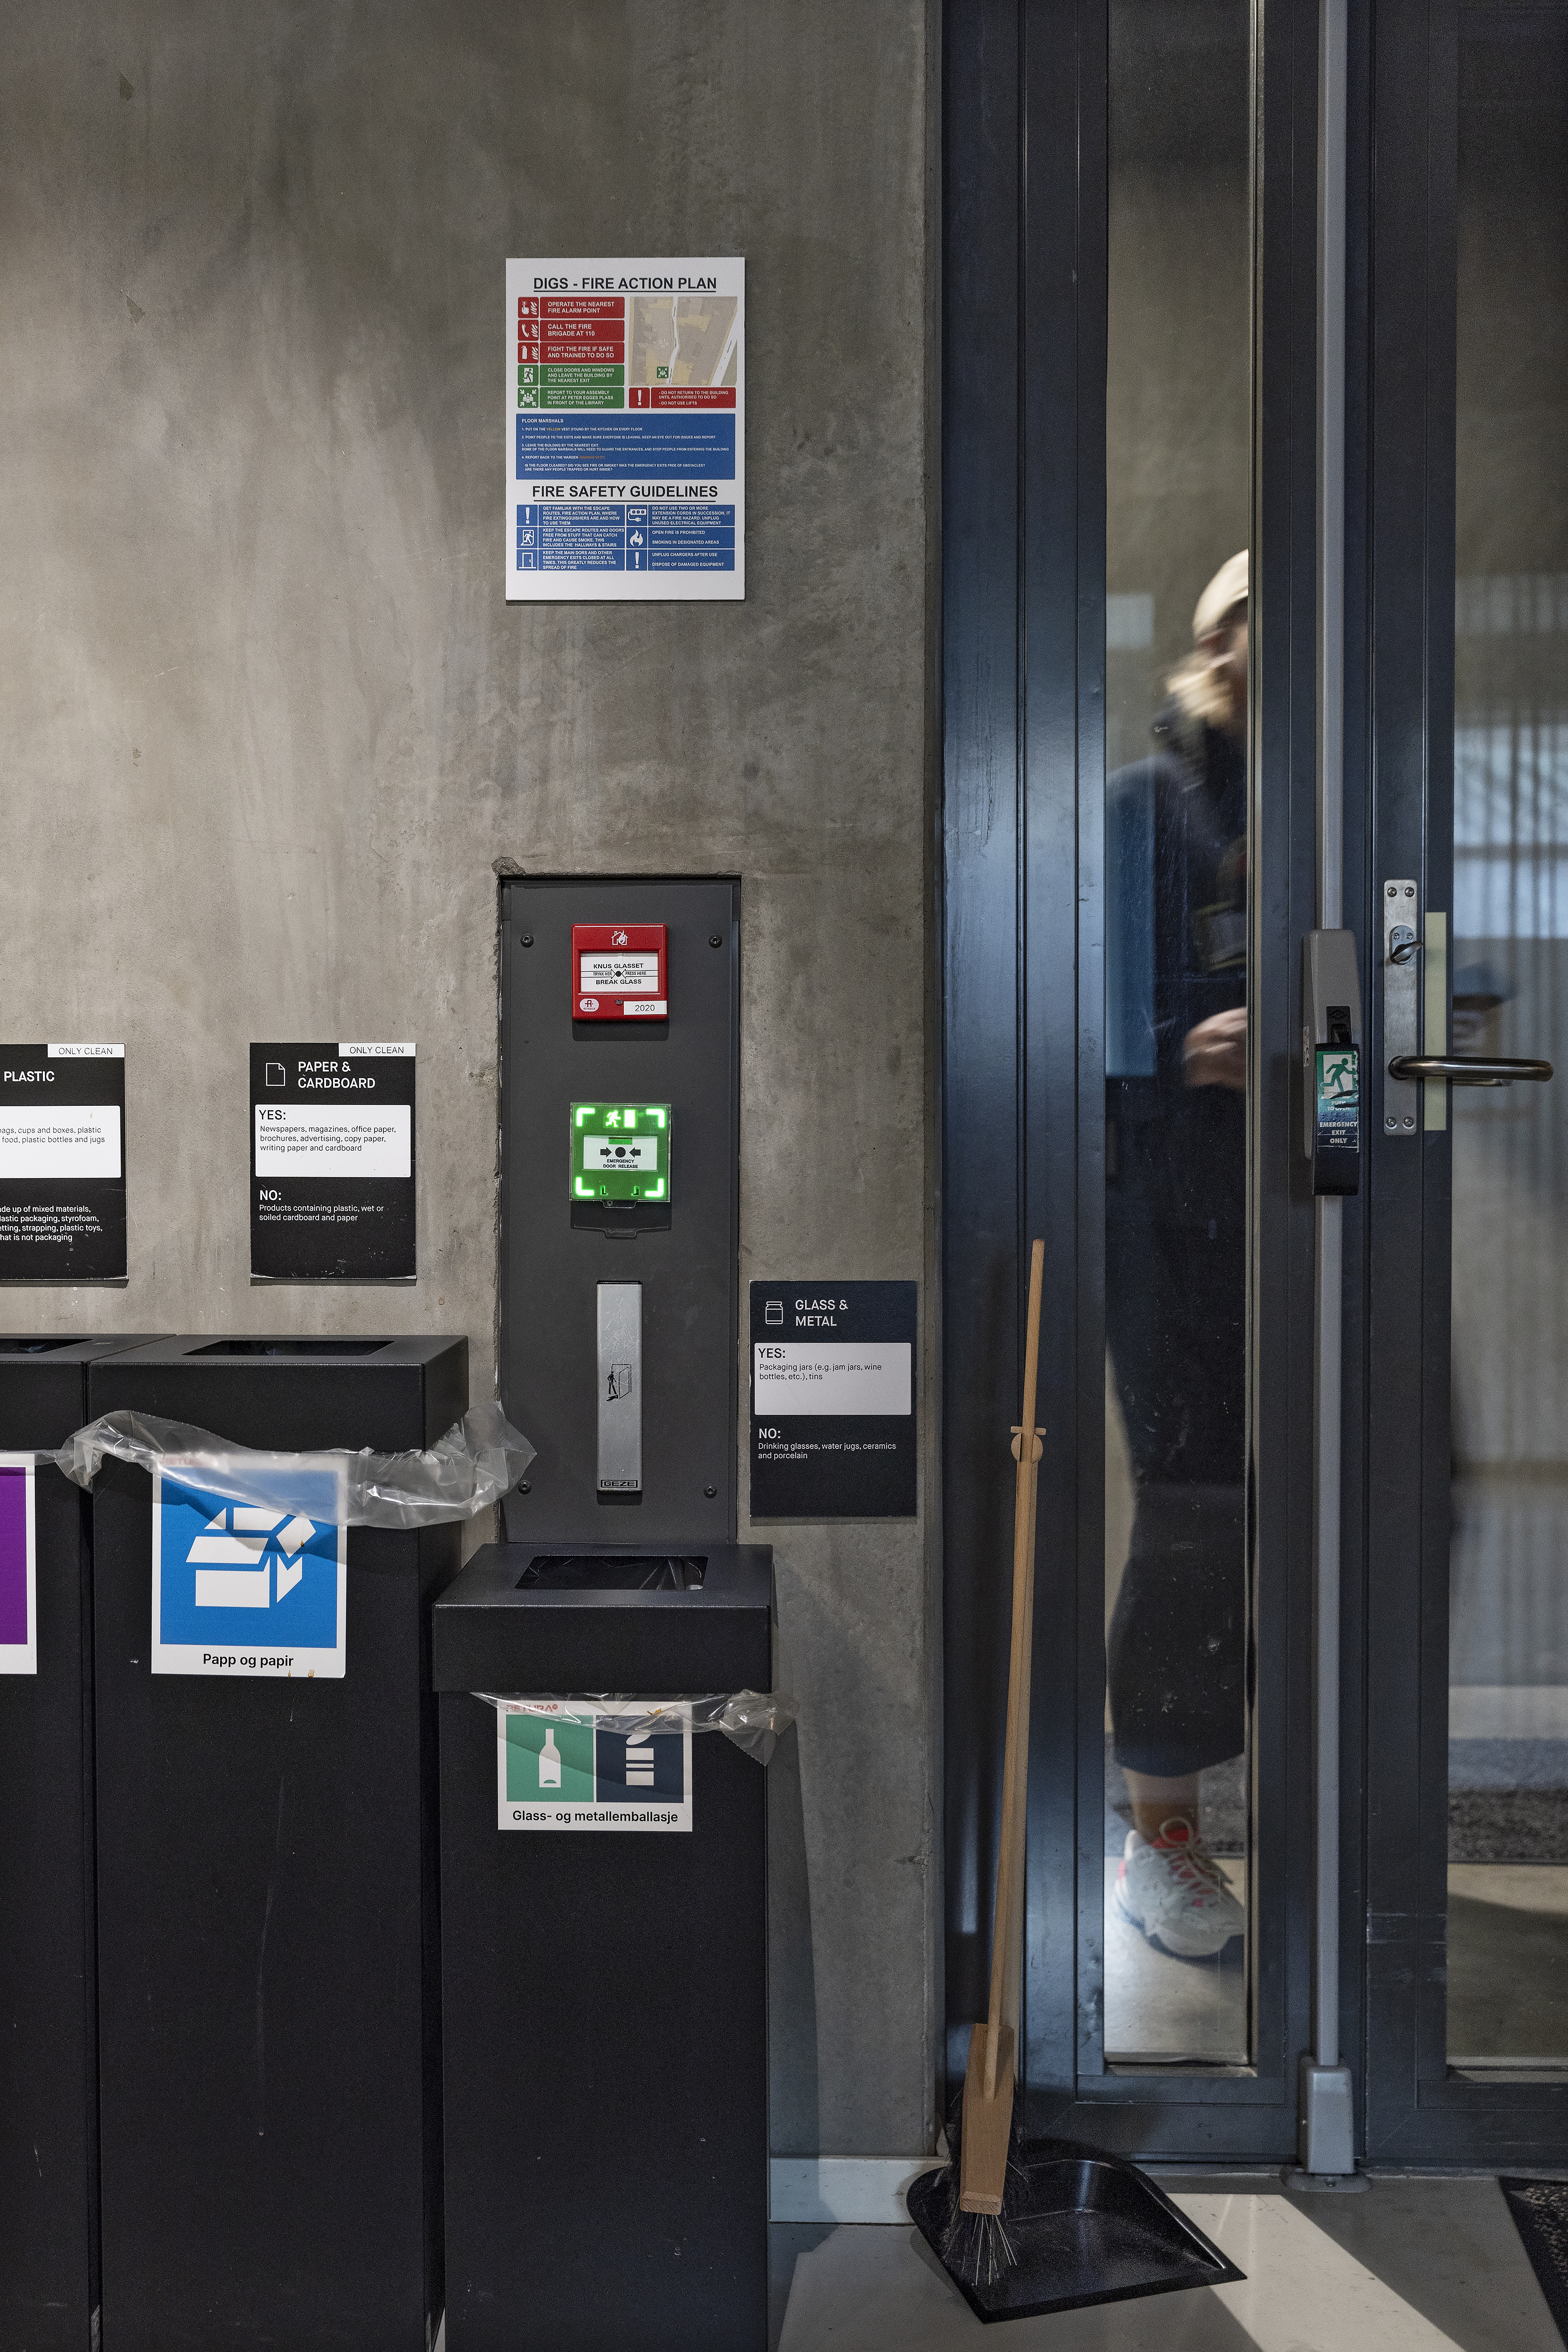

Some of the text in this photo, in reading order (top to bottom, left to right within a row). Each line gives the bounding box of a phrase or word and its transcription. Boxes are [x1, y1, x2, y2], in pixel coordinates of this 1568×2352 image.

[534, 278, 568, 289] DIGS
[582, 278, 614, 289] FIRE
[618, 278, 672, 289] ACTION
[679, 278, 716, 289] PLAN
[533, 486, 717, 497] FIRE SAFETY GUIDELINES
[299, 1062, 350, 1072] PAPER &
[4, 1071, 54, 1081] PLASTIC
[298, 1078, 375, 1088] CARDBOARD
[259, 1110, 285, 1120] YES:
[309, 1126, 350, 1134] magazines,
[90, 1136, 105, 1144] jugs
[300, 1135, 342, 1143] advertising,
[260, 1190, 281, 1200] NO:
[293, 1205, 331, 1213] containing
[334, 1205, 359, 1213] plastic,
[20, 1215, 60, 1223] packaging,
[61, 1215, 99, 1223] styrofoam,
[22, 1224, 58, 1232] strapping,
[60, 1224, 84, 1232] plastic
[36, 1234, 72, 1242] packaging
[795, 1300, 848, 1310] GLASS &
[796, 1316, 837, 1326] METAL
[758, 1348, 785, 1358] YES:
[760, 1364, 797, 1372] Packaging
[815, 1364, 831, 1372] (e.g.
[833, 1364, 845, 1372] jam
[847, 1364, 863, 1372] jars,
[789, 1373, 807, 1381] etc.),
[759, 1428, 780, 1439] NO:
[759, 1443, 788, 1451] Drinking
[844, 1443, 861, 1451] jugs,
[774, 1452, 807, 1460] porcelain
[204, 1654, 293, 1668] Papp og papir
[513, 1810, 678, 1824] Glass- og metallemballasje
